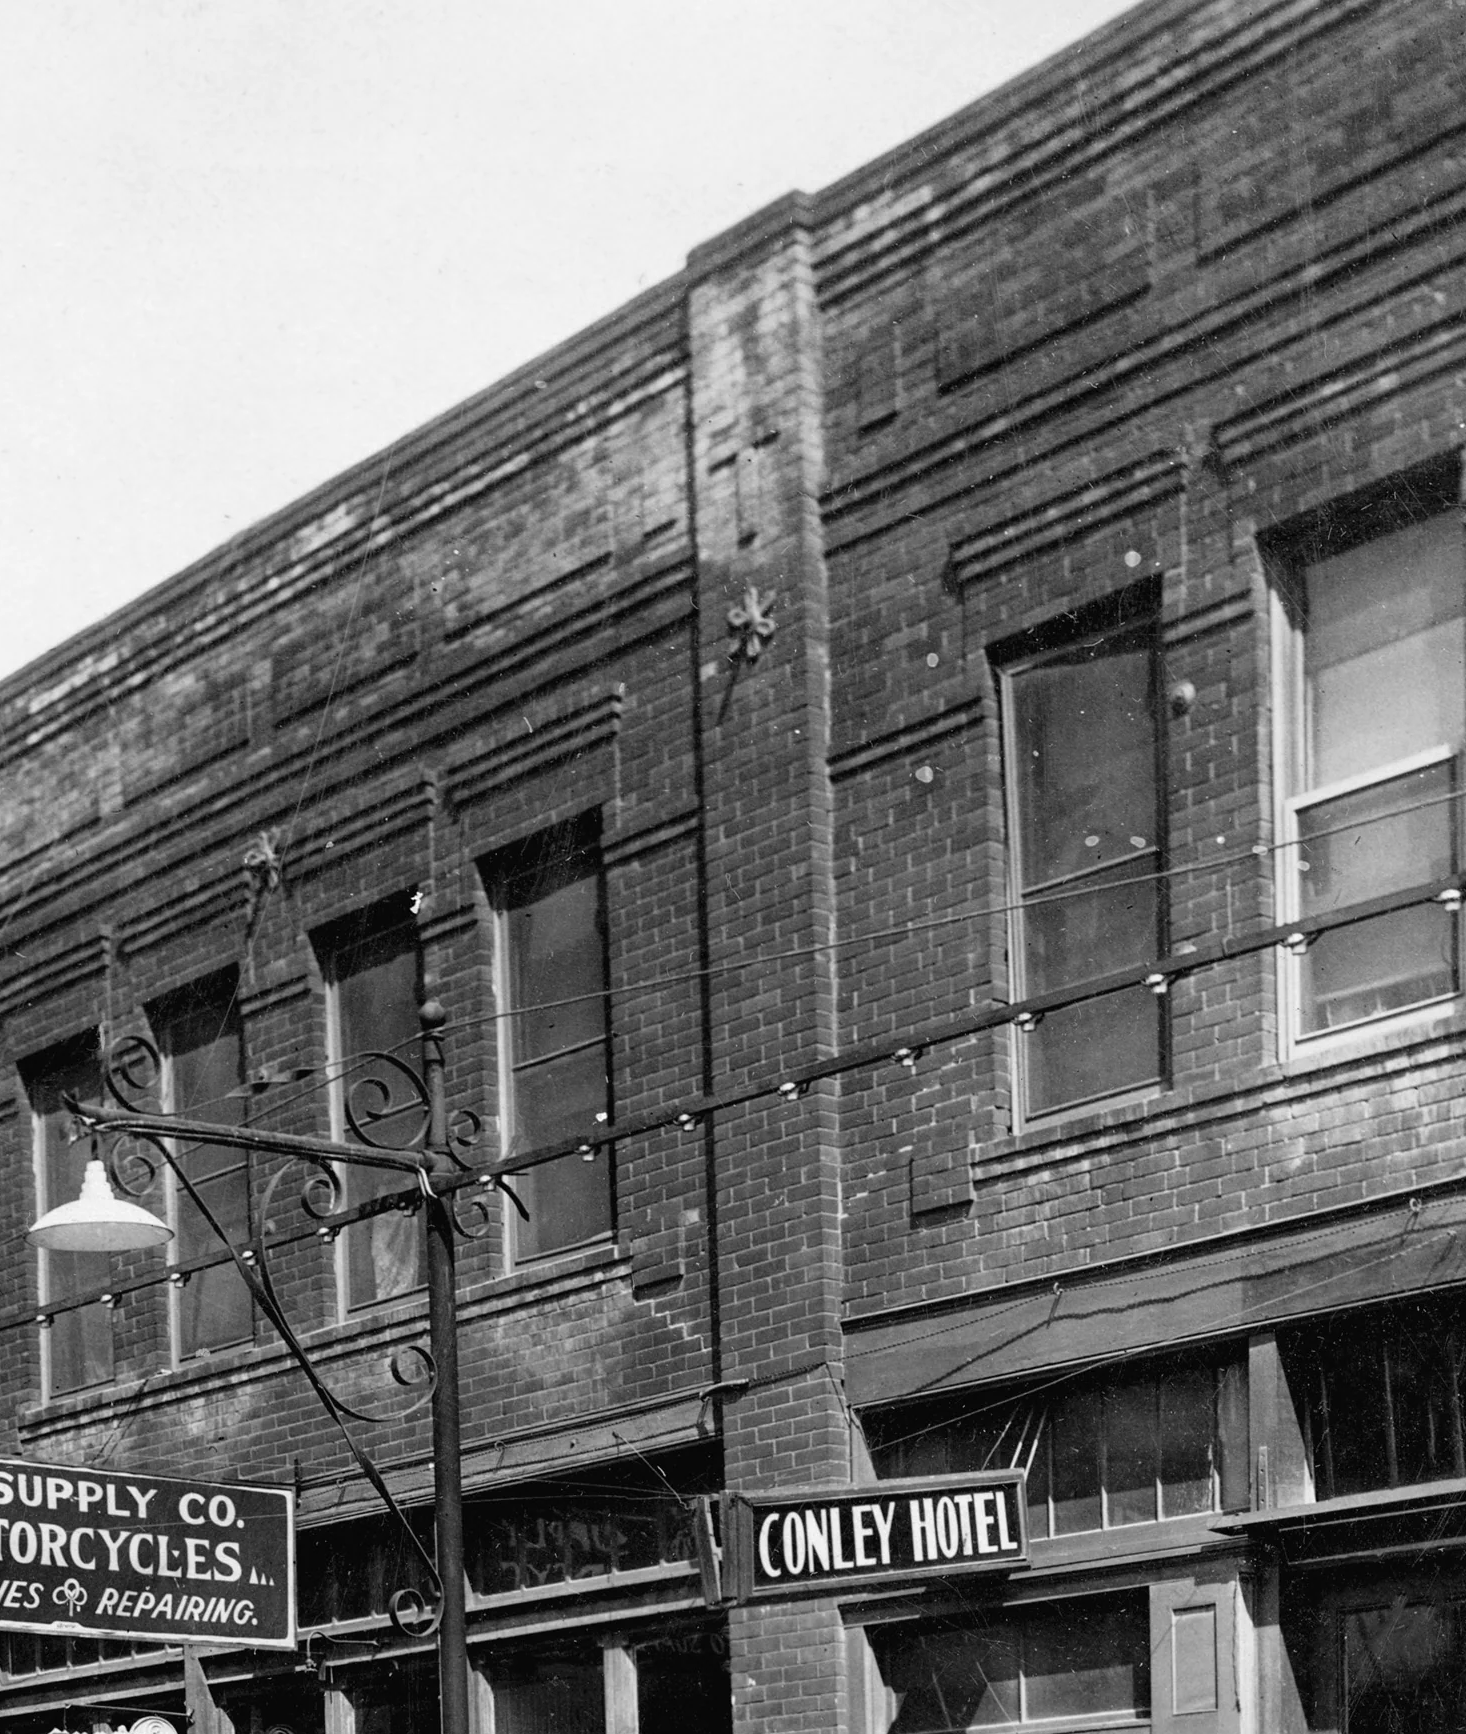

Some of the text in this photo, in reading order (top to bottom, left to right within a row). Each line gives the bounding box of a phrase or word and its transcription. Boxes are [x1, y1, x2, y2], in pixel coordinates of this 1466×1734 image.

[179, 1492, 246, 1529] CO.
[758, 1491, 1018, 1578] CONLEY HOTEL
[95, 1588, 259, 1626] REPAIRING.
